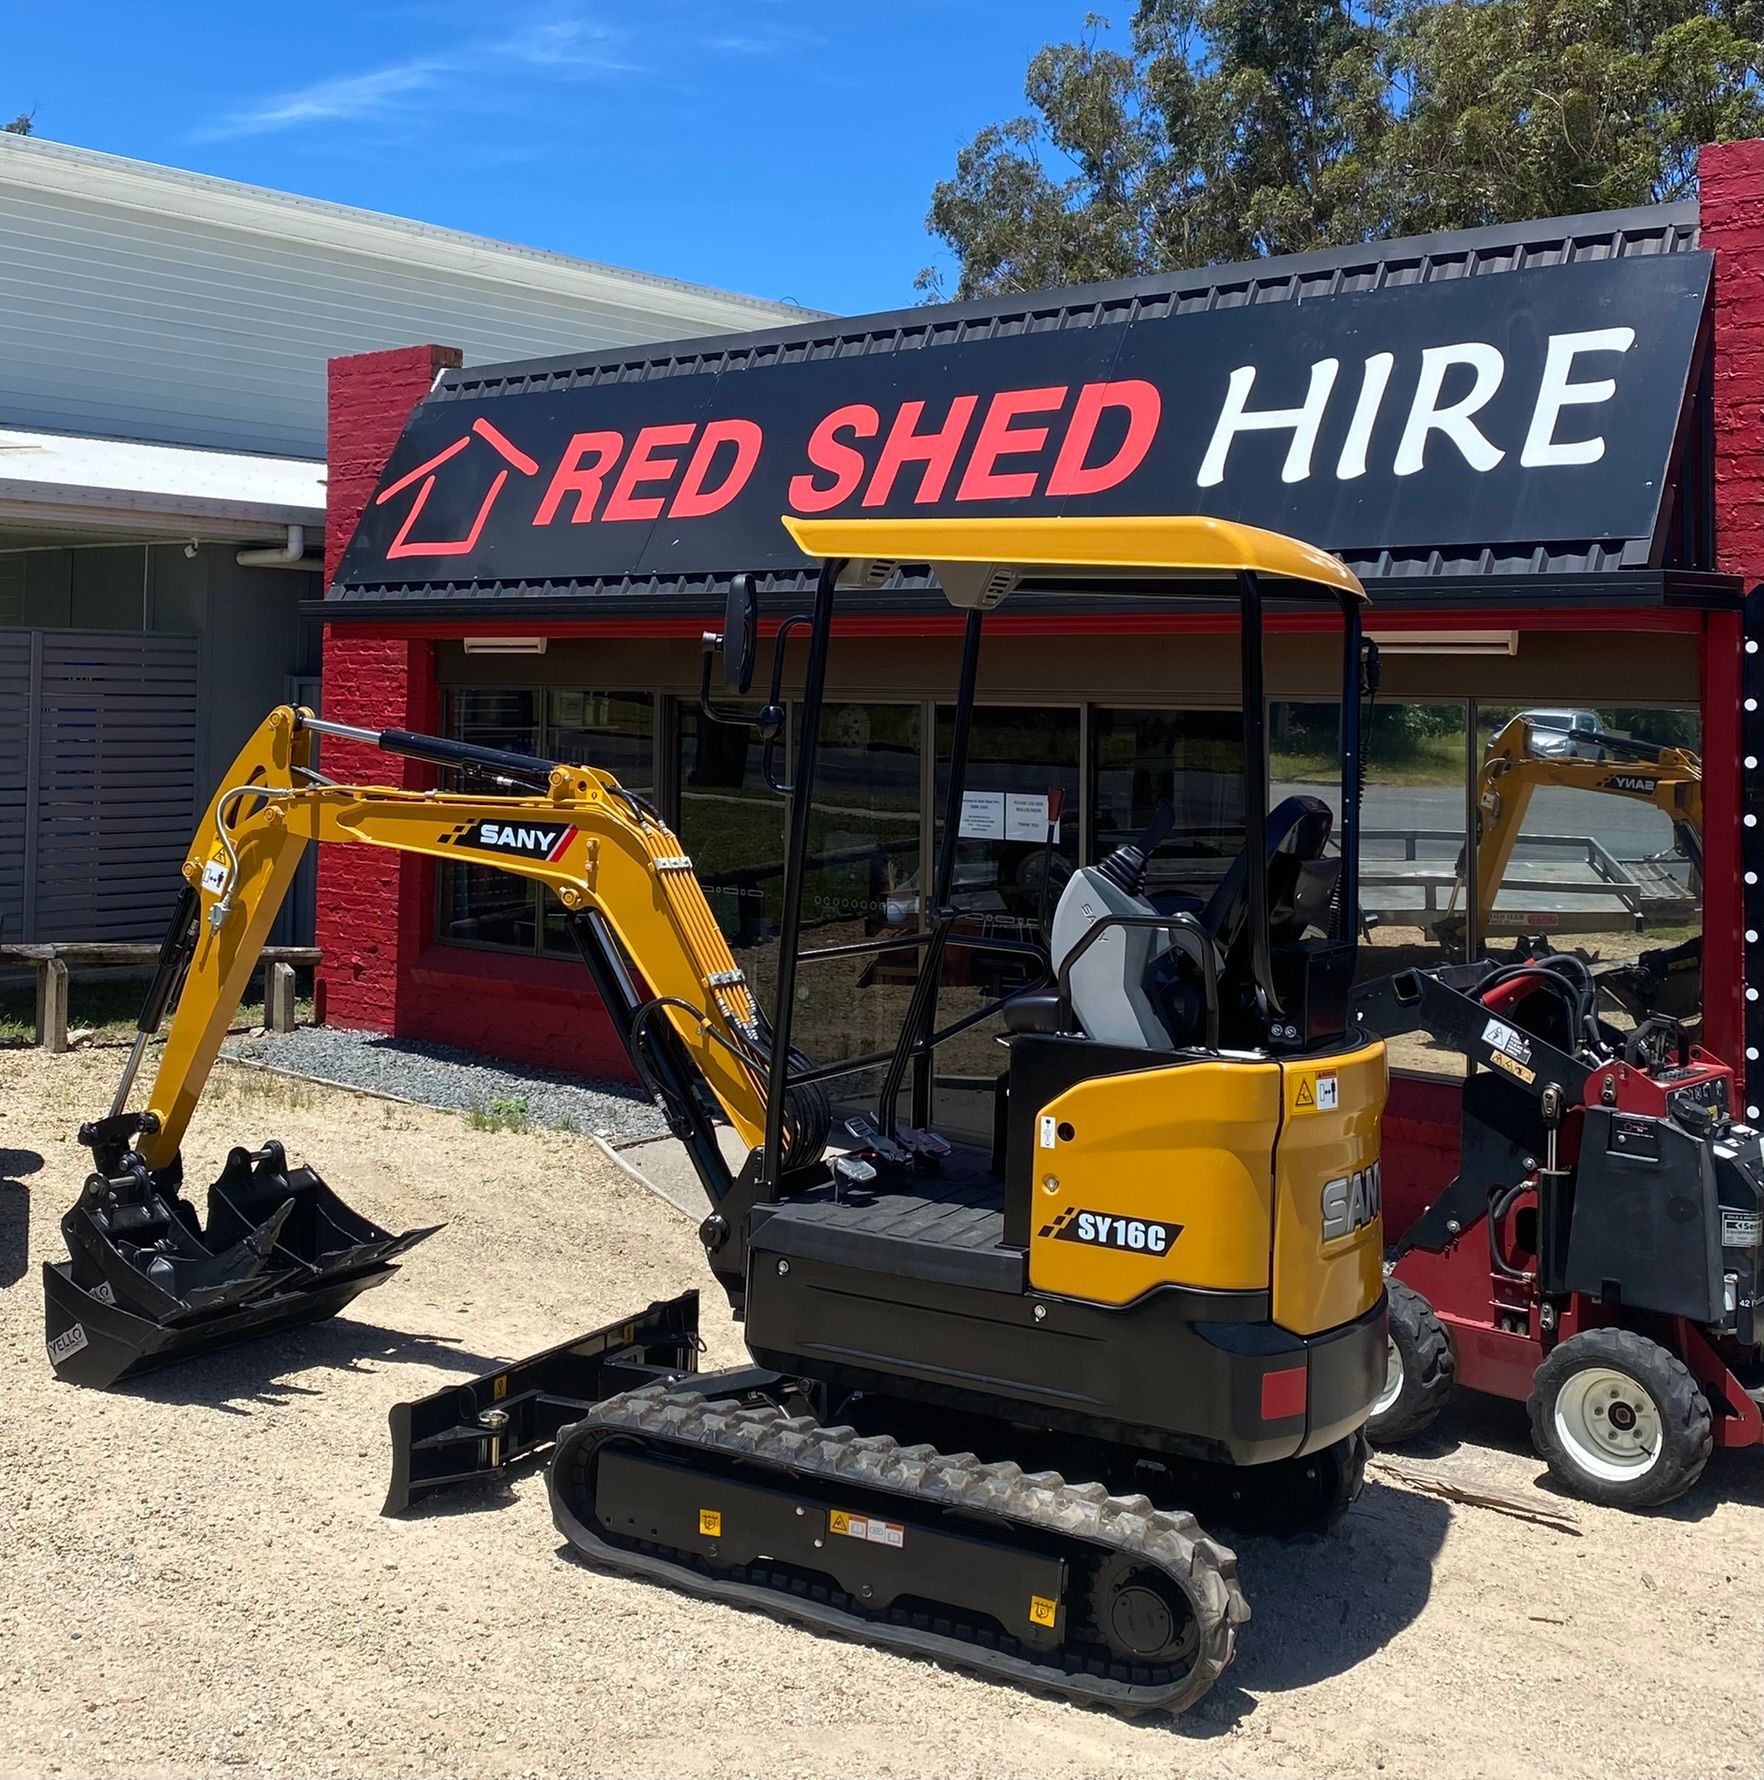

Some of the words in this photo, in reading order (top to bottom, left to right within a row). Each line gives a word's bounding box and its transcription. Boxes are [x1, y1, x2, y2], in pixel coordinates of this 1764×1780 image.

[532, 418, 763, 526] RED
[788, 379, 1162, 513] SHED
[1197, 327, 1636, 488] HIRE
[479, 823, 557, 851] SANY
[1081, 903, 1109, 943] SAY
[1323, 1162, 1381, 1240] SAN
[1078, 1213, 1166, 1252] SY16C
[48, 1328, 82, 1354] YELLO
